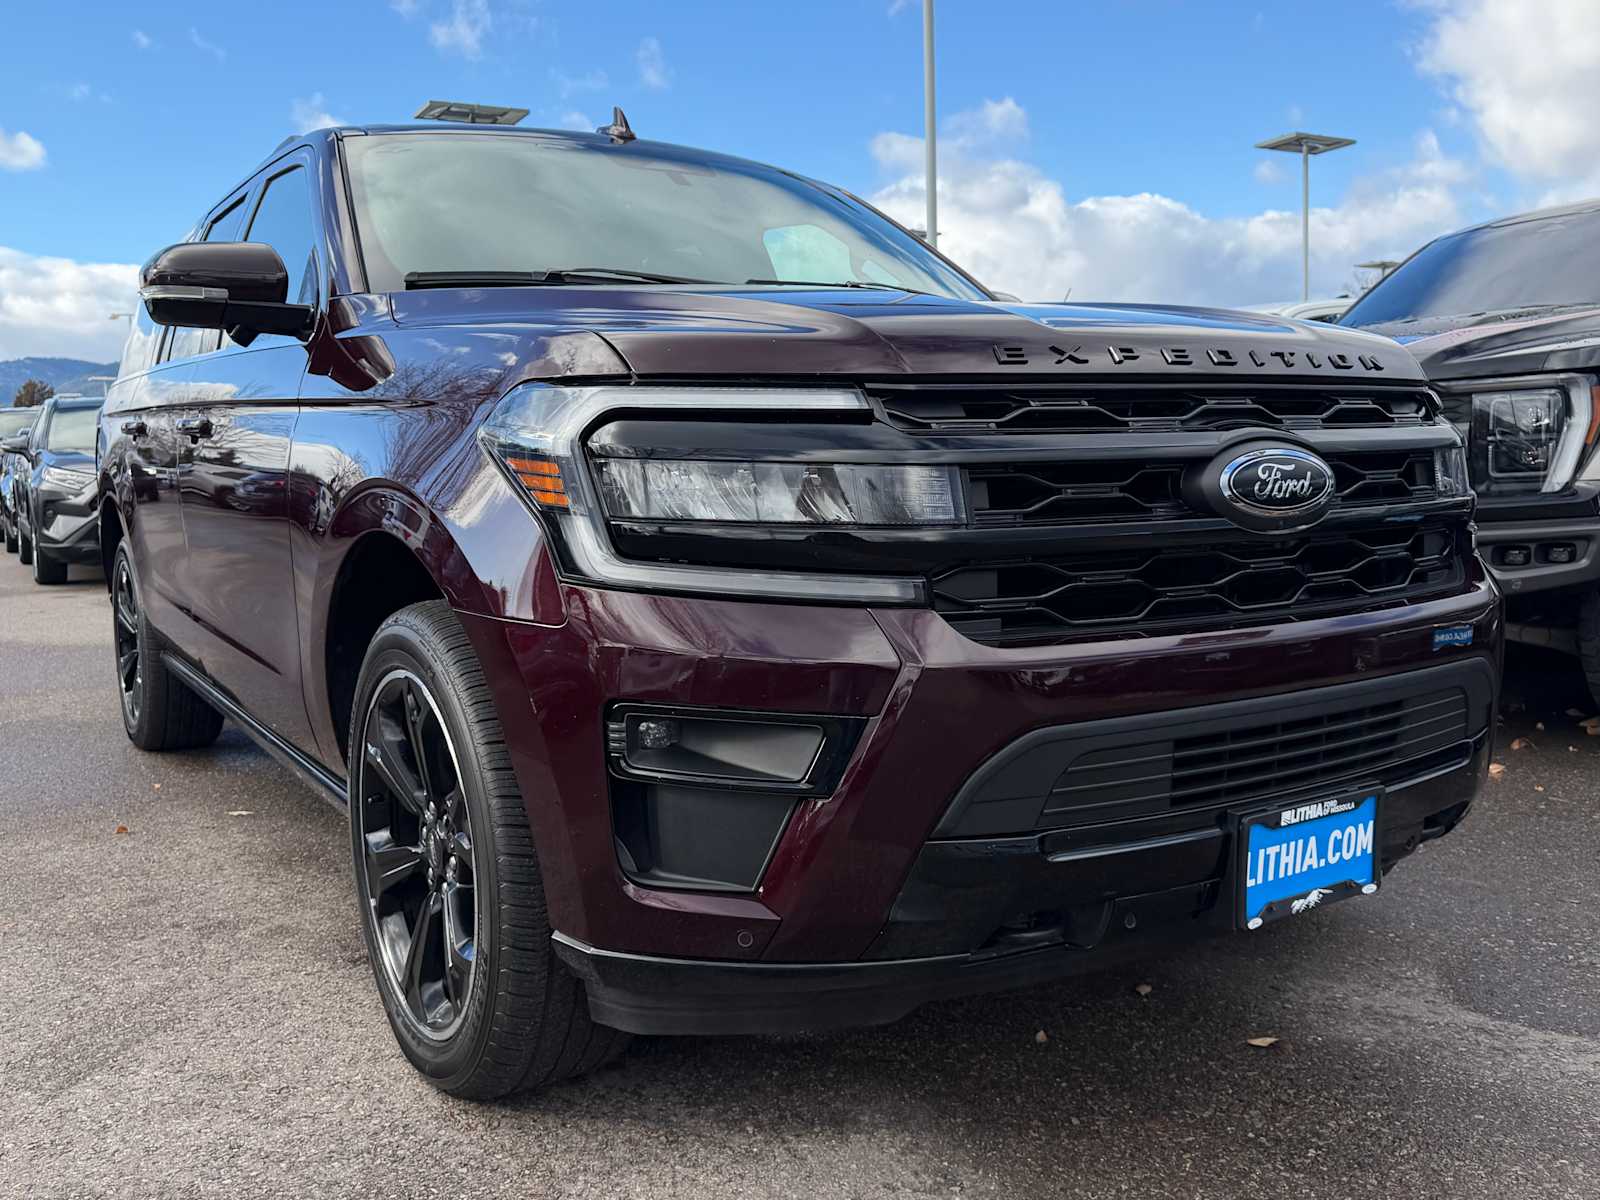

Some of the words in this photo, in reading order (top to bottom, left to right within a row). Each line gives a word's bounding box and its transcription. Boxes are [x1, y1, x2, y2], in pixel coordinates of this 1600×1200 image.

[993, 344, 1385, 371] EXPEDITION
[1254, 463, 1313, 499] Ford
[1291, 803, 1323, 824] LITHIA
[1246, 820, 1374, 888] LITHIA.COM
